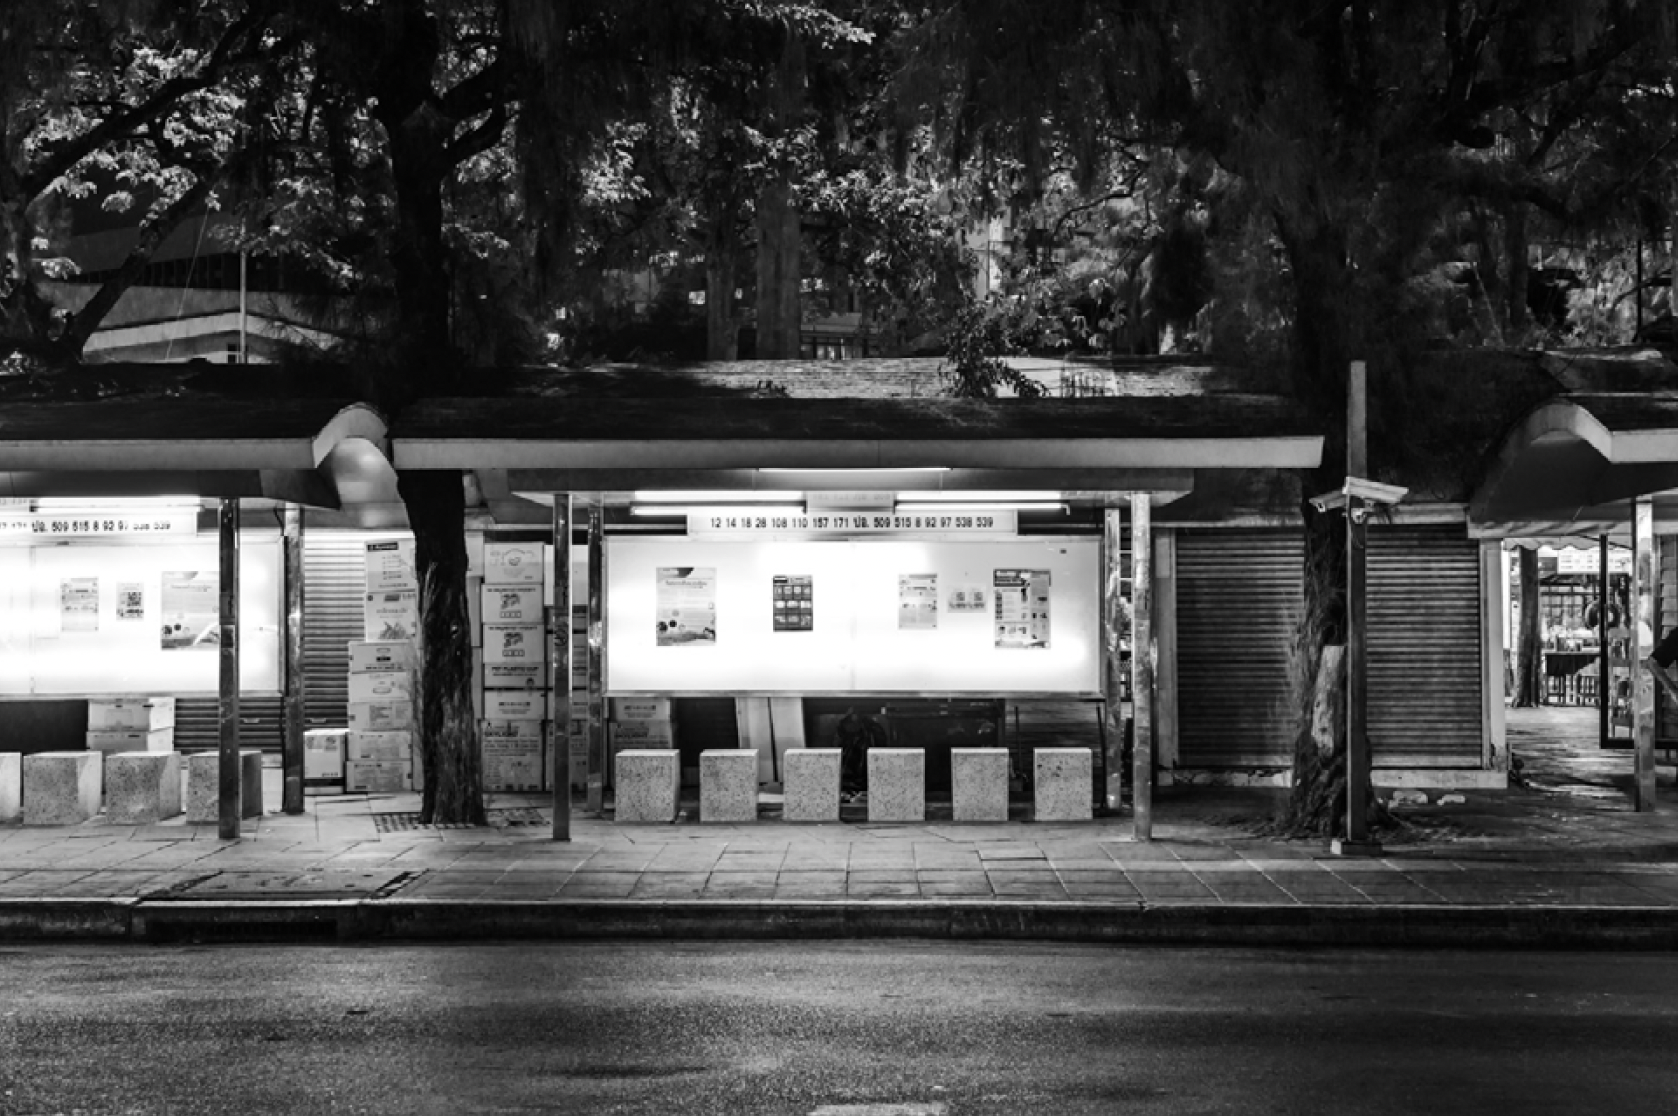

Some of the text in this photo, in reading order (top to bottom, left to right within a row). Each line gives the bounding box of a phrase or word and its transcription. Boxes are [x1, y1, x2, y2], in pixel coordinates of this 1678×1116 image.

[51, 520, 69, 532] 509
[72, 520, 90, 532] 515
[92, 520, 99, 532] 8
[103, 520, 115, 532] 92
[710, 516, 721, 528] 12
[726, 516, 737, 528] 14
[792, 516, 808, 528] 110
[813, 516, 829, 528] 157
[833, 516, 849, 528] 171
[873, 516, 890, 528] 509
[894, 516, 911, 528] 515
[915, 516, 922, 528] 8
[925, 516, 937, 528] 92
[940, 516, 952, 528] 97
[955, 516, 973, 528] 538
[976, 516, 993, 528] 539
